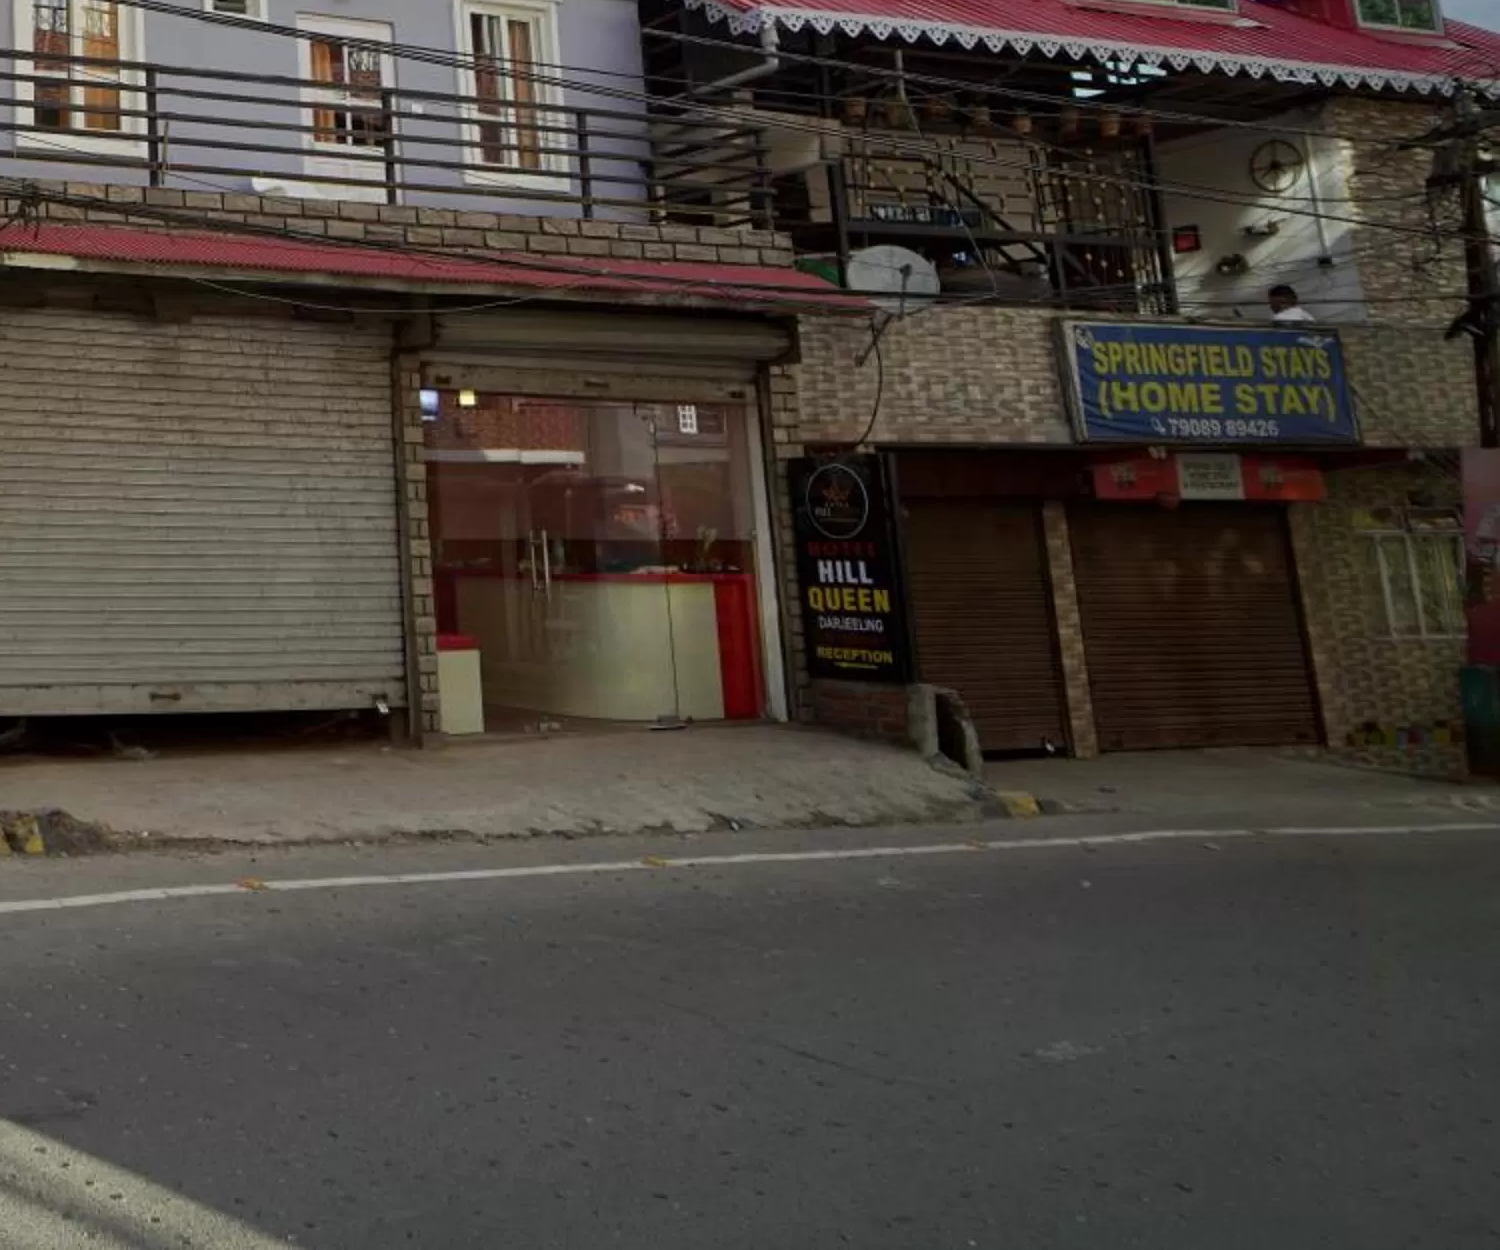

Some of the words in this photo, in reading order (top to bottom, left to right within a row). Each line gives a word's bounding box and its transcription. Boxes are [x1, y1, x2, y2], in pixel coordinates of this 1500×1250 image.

[1093, 342, 1253, 378] SPRINGFIELD
[1262, 347, 1331, 379] STAYS
[817, 560, 873, 584] HILL
[808, 587, 891, 614] QUEEN
[816, 646, 893, 665] RECEPTION
